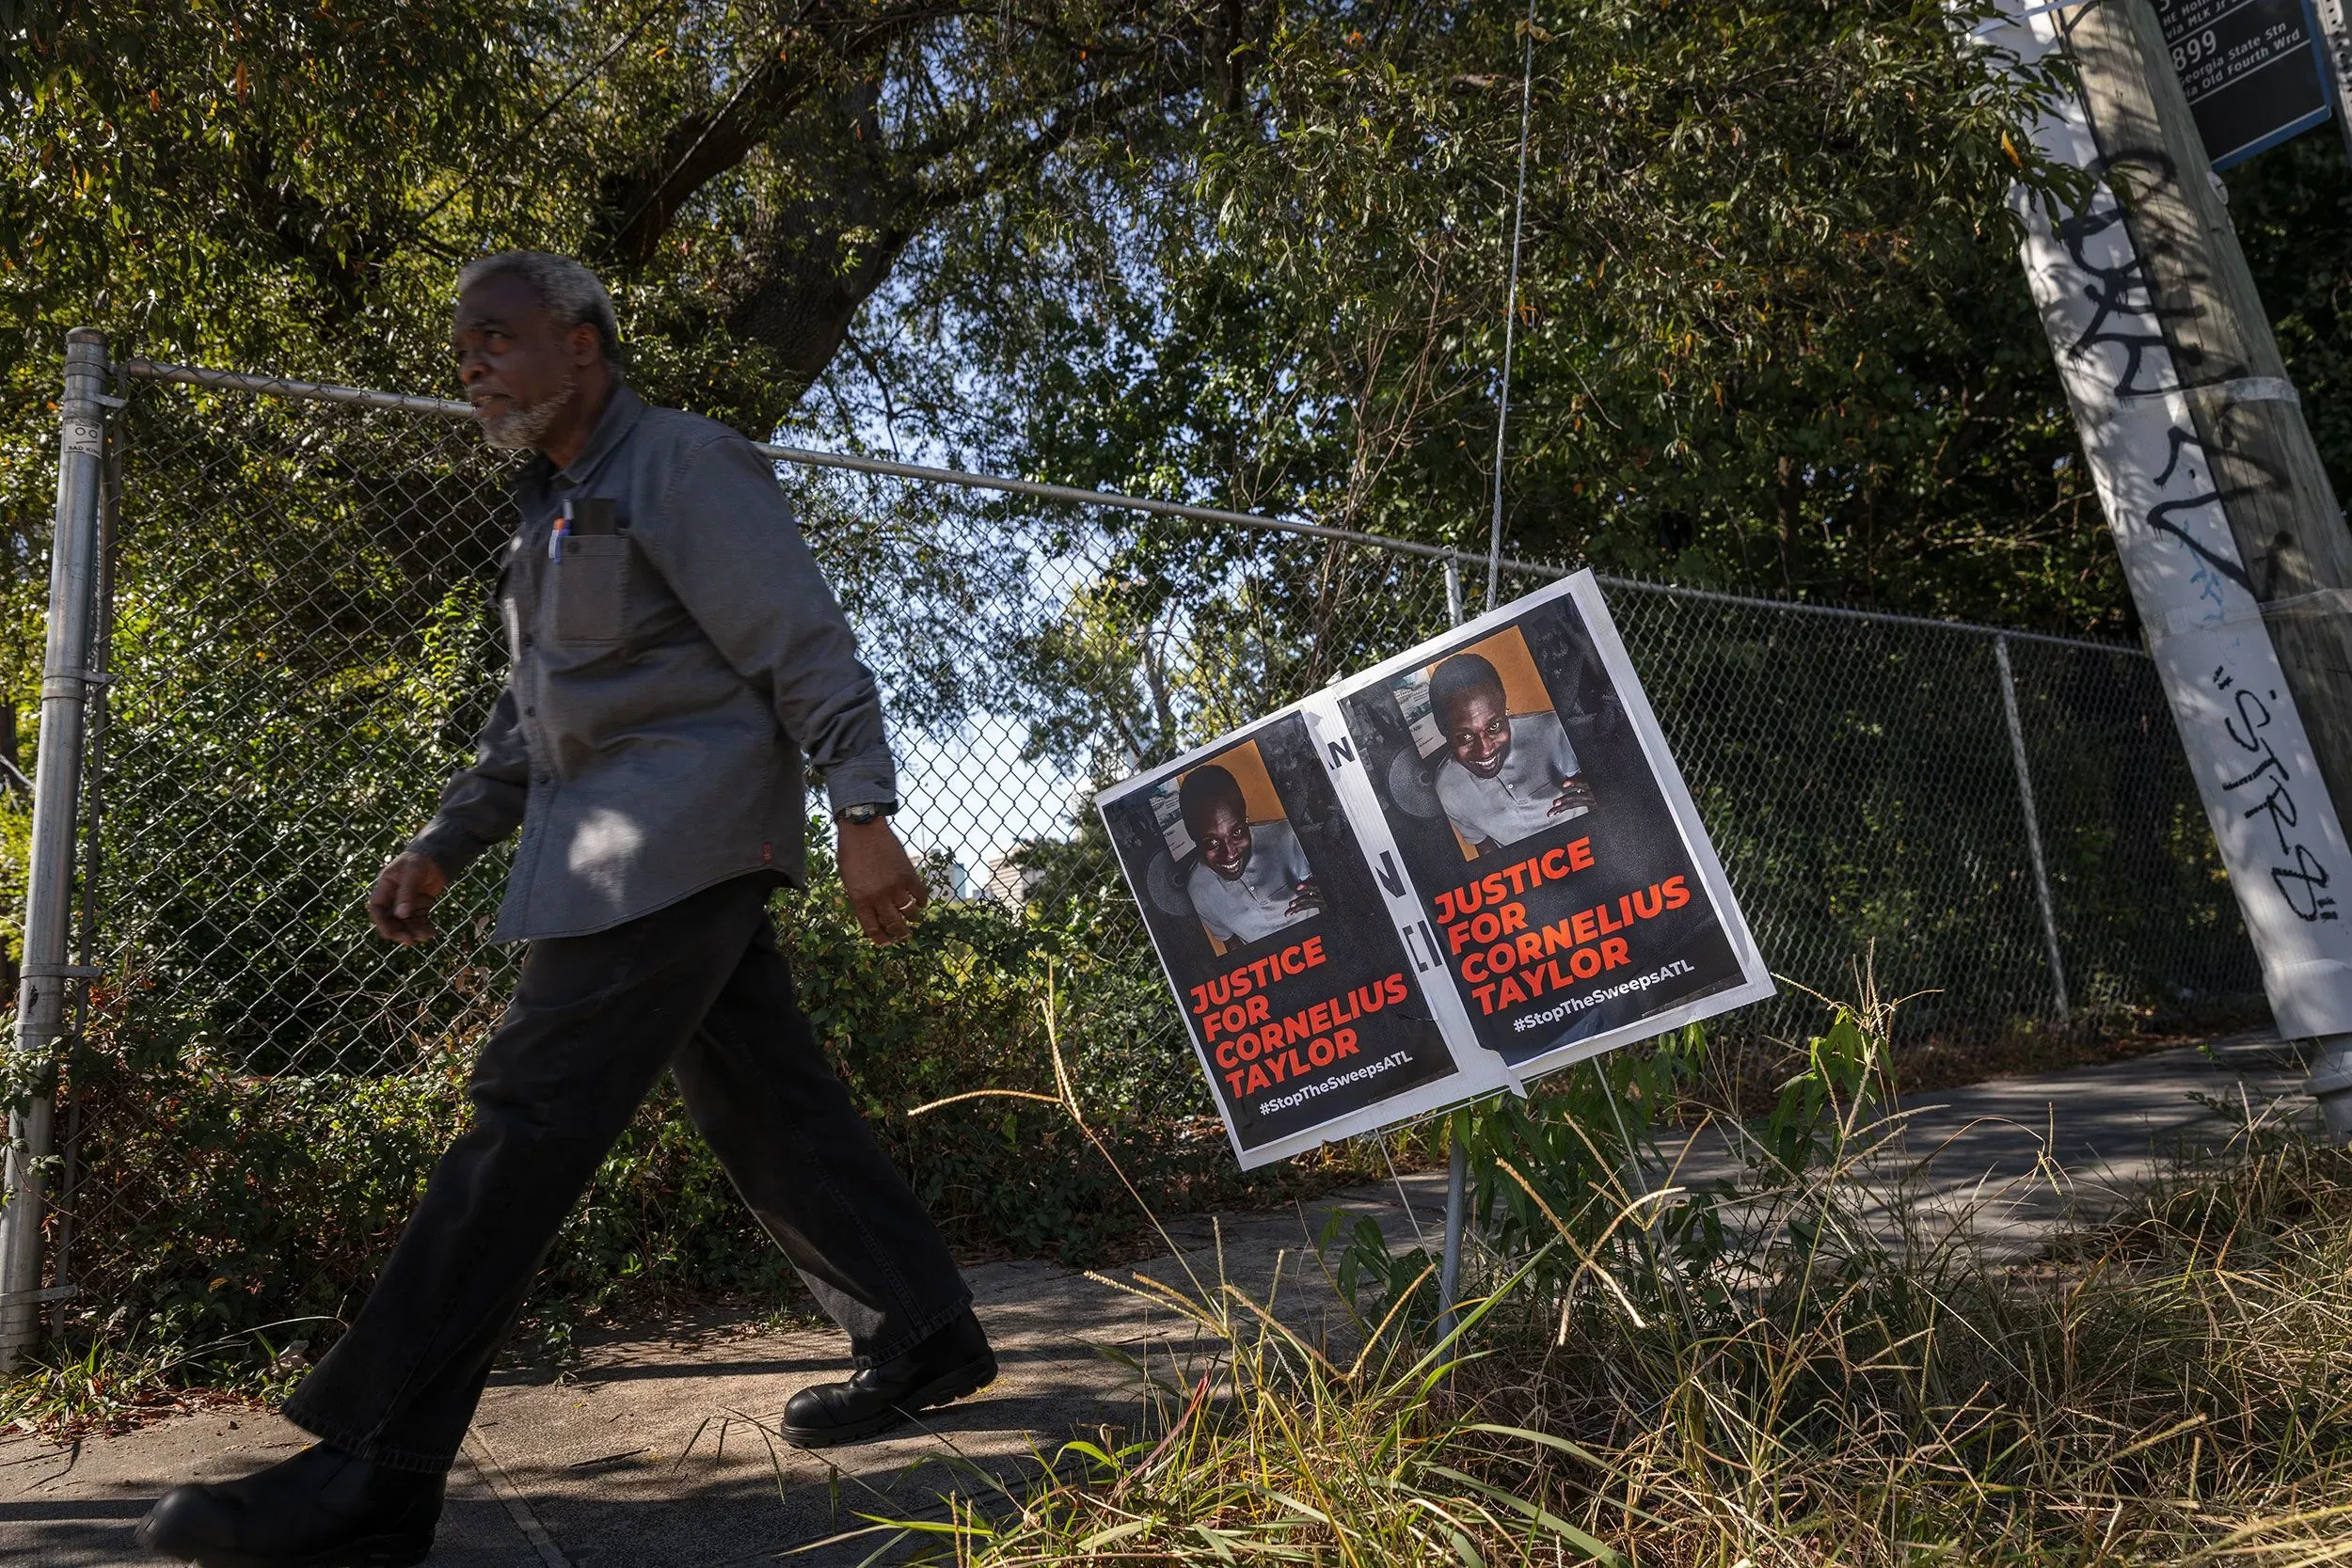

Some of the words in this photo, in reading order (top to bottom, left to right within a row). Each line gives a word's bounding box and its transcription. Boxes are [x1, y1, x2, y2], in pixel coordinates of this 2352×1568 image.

[2167, 24, 2184, 39] via
[2188, 7, 2211, 27] MLK
[2171, 29, 2217, 71] 899
[2227, 36, 2261, 60] State
[2265, 22, 2287, 41] Stn
[2201, 69, 2223, 89] Old
[2227, 46, 2269, 75] Fourth
[2273, 28, 2301, 51] Wrd
[1435, 836, 1595, 924] JUSTICE
[1447, 901, 1529, 956] FOR
[1461, 875, 1691, 984] CORNELIUS
[1190, 935, 1327, 1014] JUSTICE
[1471, 937, 1631, 1016] TAYLOR
[1513, 958, 1694, 1033] #StopTheSweepsATL
[1202, 994, 1271, 1042] FOR
[1216, 973, 1408, 1069] CORNELIUS
[1225, 1028, 1360, 1099] TAYLOR
[1259, 1050, 1413, 1117] #StopTheSweepsATL
